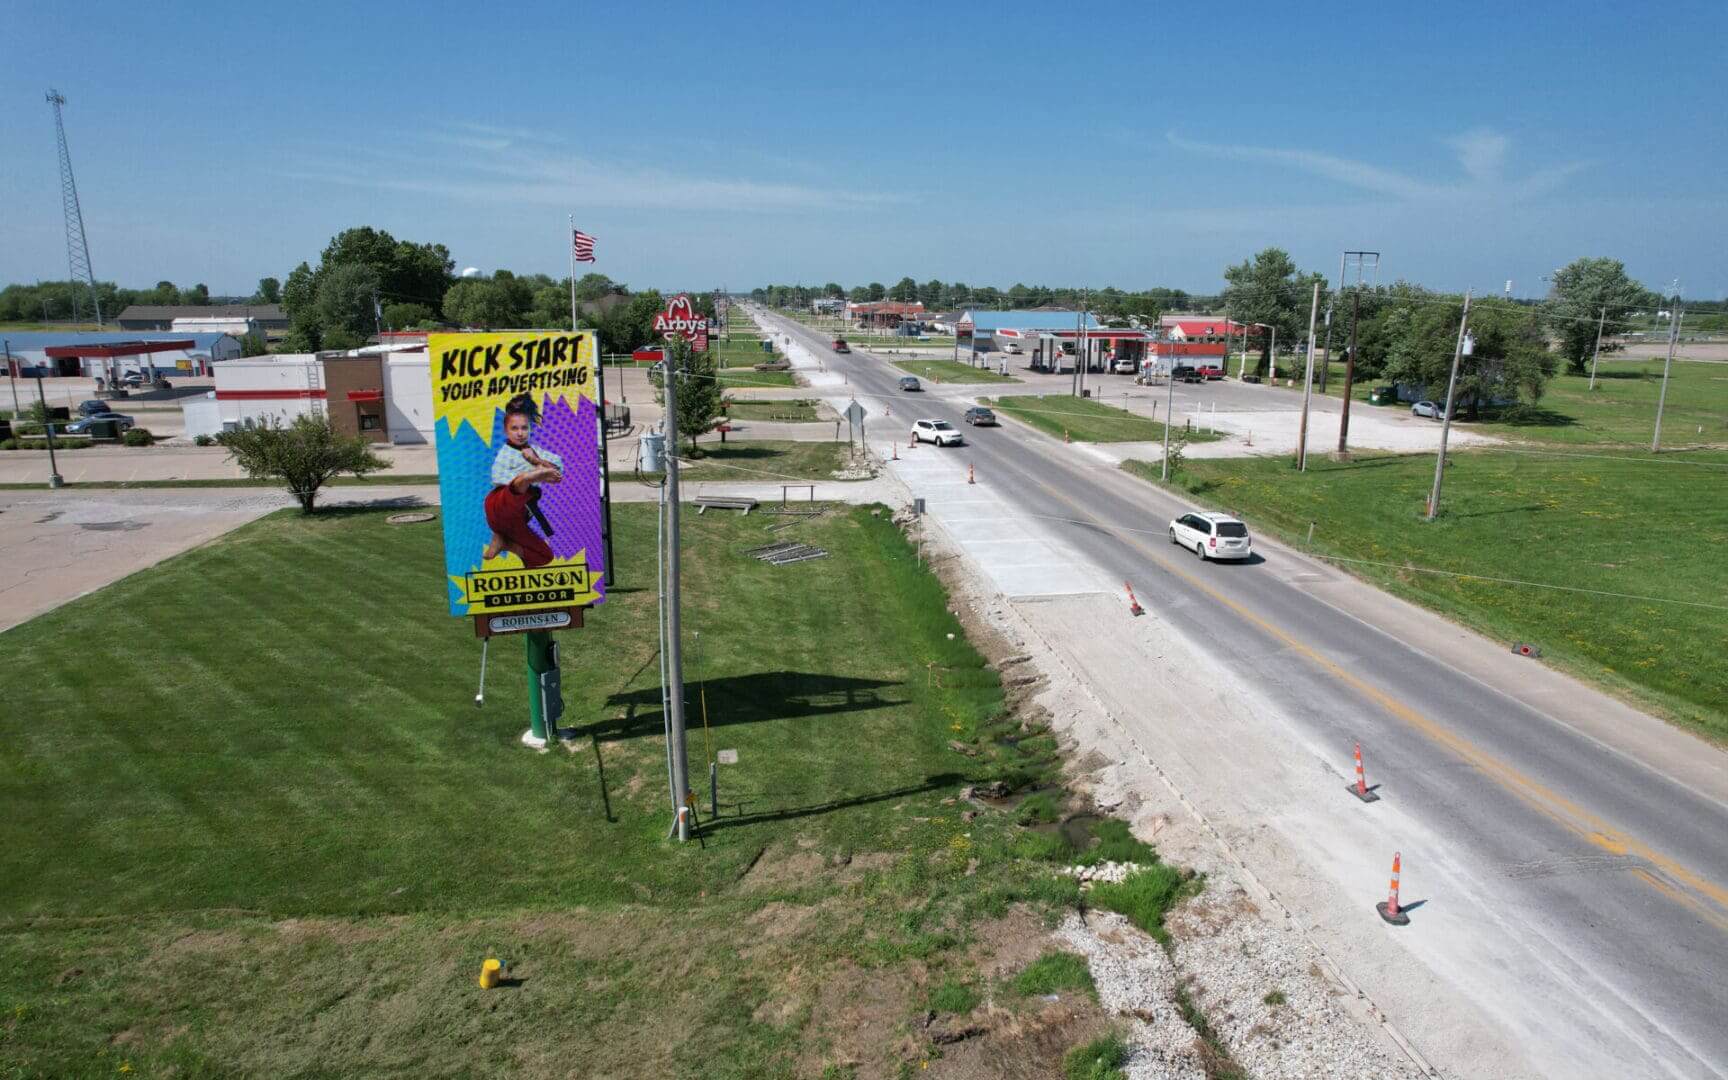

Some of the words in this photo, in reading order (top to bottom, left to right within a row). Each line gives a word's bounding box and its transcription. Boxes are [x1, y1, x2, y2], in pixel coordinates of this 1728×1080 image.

[655, 315, 706, 335] Arby's
[441, 344, 502, 381] KICK
[509, 334, 584, 371] START
[441, 379, 484, 402] YOUR
[488, 366, 588, 397] ADVERTISING
[491, 590, 568, 606] OUTDOOR
[501, 614, 558, 628] ROBINSN
